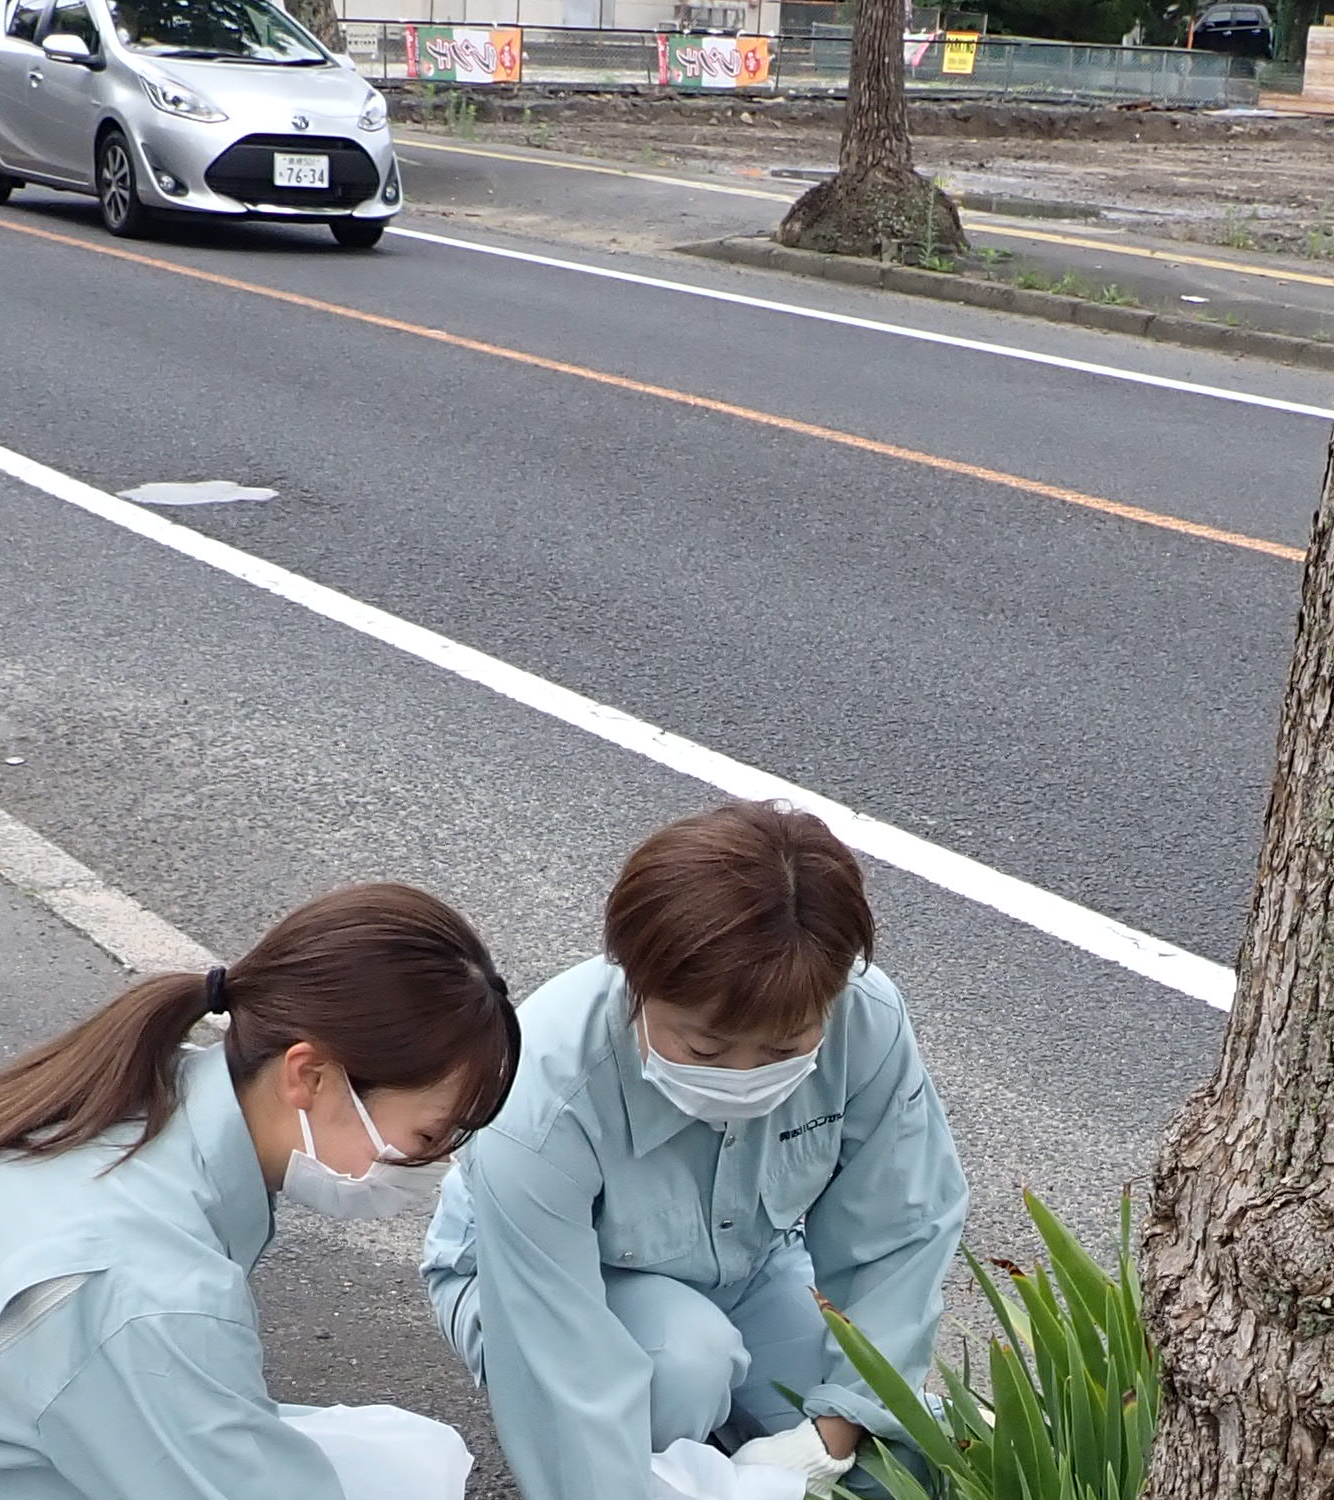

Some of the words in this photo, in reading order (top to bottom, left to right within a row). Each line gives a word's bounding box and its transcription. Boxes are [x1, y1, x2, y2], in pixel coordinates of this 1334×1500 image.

[426, 38, 497, 74] ランチ
[676, 46, 741, 78] ランチ
[286, 167, 325, 185] 76-34
